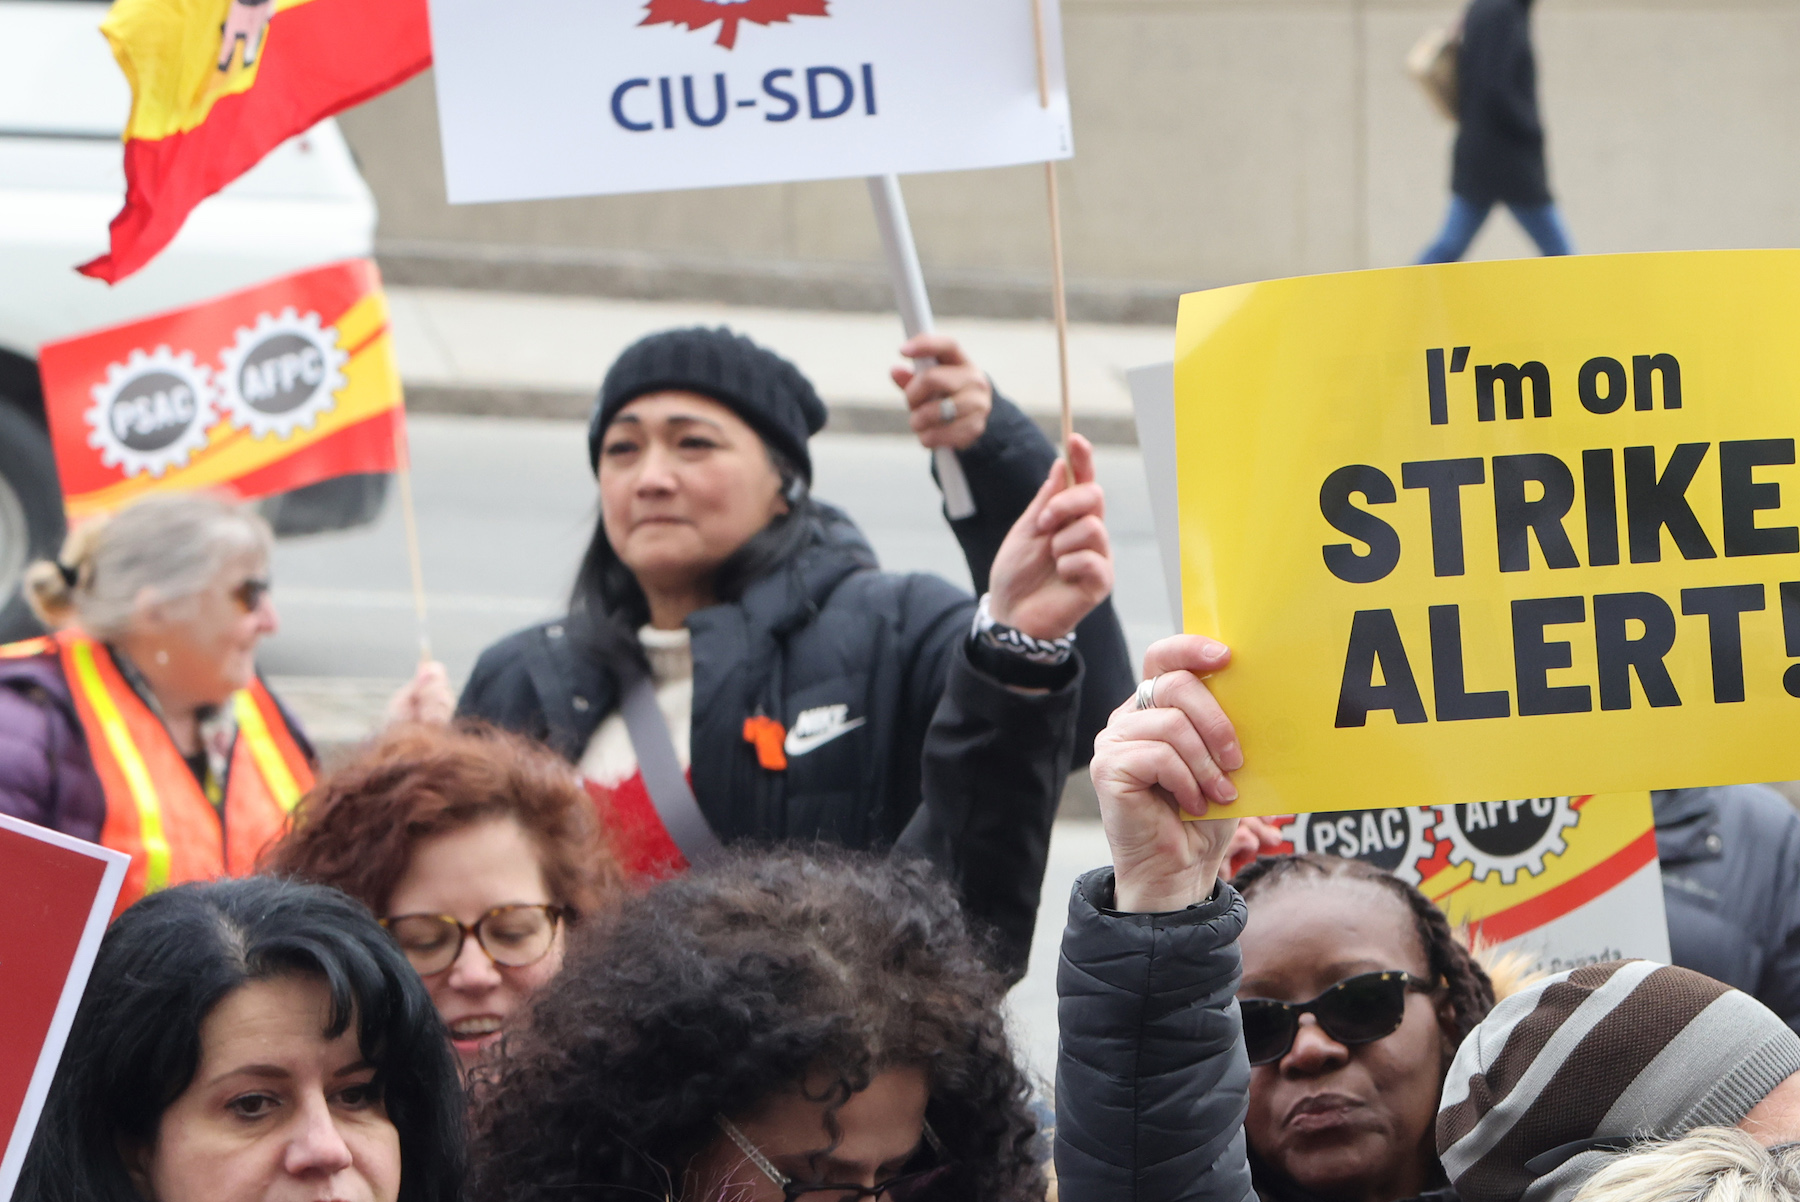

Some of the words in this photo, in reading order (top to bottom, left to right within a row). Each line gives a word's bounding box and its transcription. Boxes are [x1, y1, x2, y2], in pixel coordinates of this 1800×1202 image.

[610, 63, 877, 132] CIU-SDI
[242, 347, 323, 407] AFPC
[1426, 346, 1552, 425] I'm
[1578, 353, 1682, 415] on
[112, 384, 194, 440] PSAC
[1319, 438, 1800, 584] STRIKE
[1312, 808, 1405, 858] PSAC
